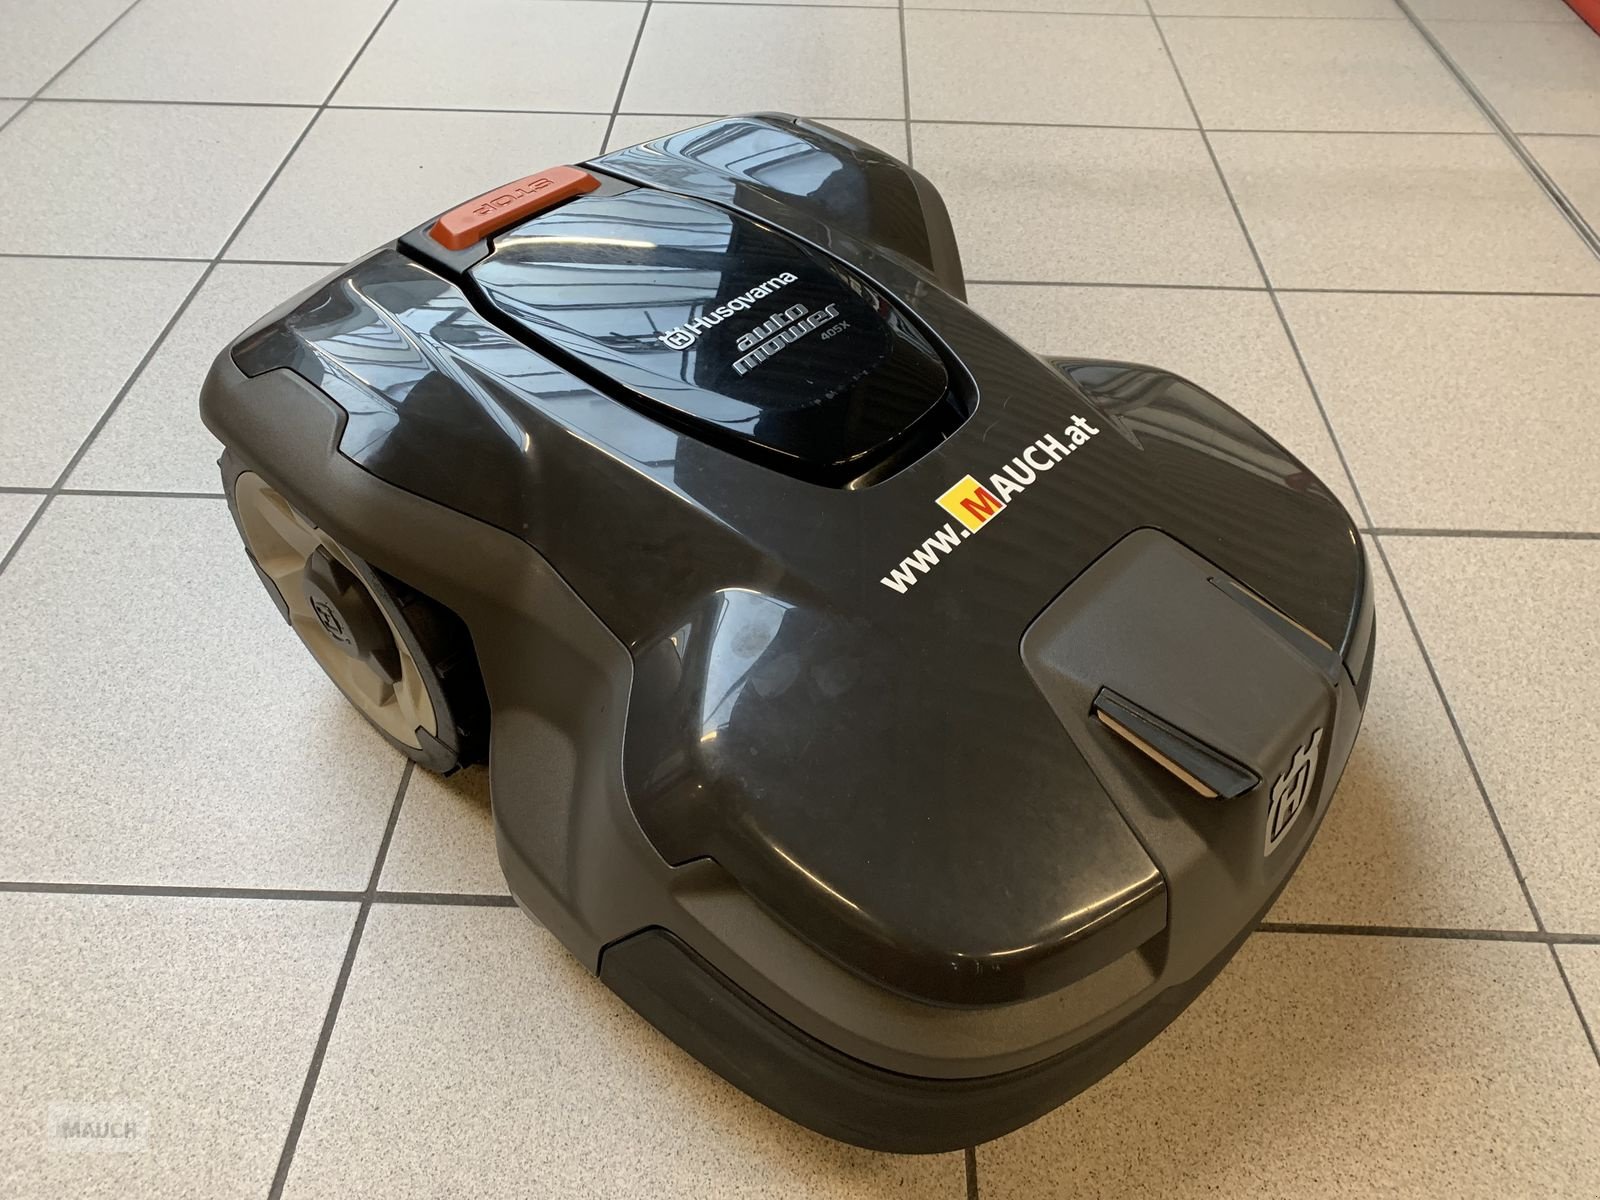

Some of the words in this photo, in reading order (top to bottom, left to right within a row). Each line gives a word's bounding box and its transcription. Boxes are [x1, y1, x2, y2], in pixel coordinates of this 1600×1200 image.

[472, 177, 554, 216] STOP
[684, 272, 799, 337] Husqvarna
[736, 303, 809, 352] auto
[820, 320, 851, 342] 405X
[732, 303, 841, 376] mower
[880, 414, 1100, 595] www.MAUCH.at
